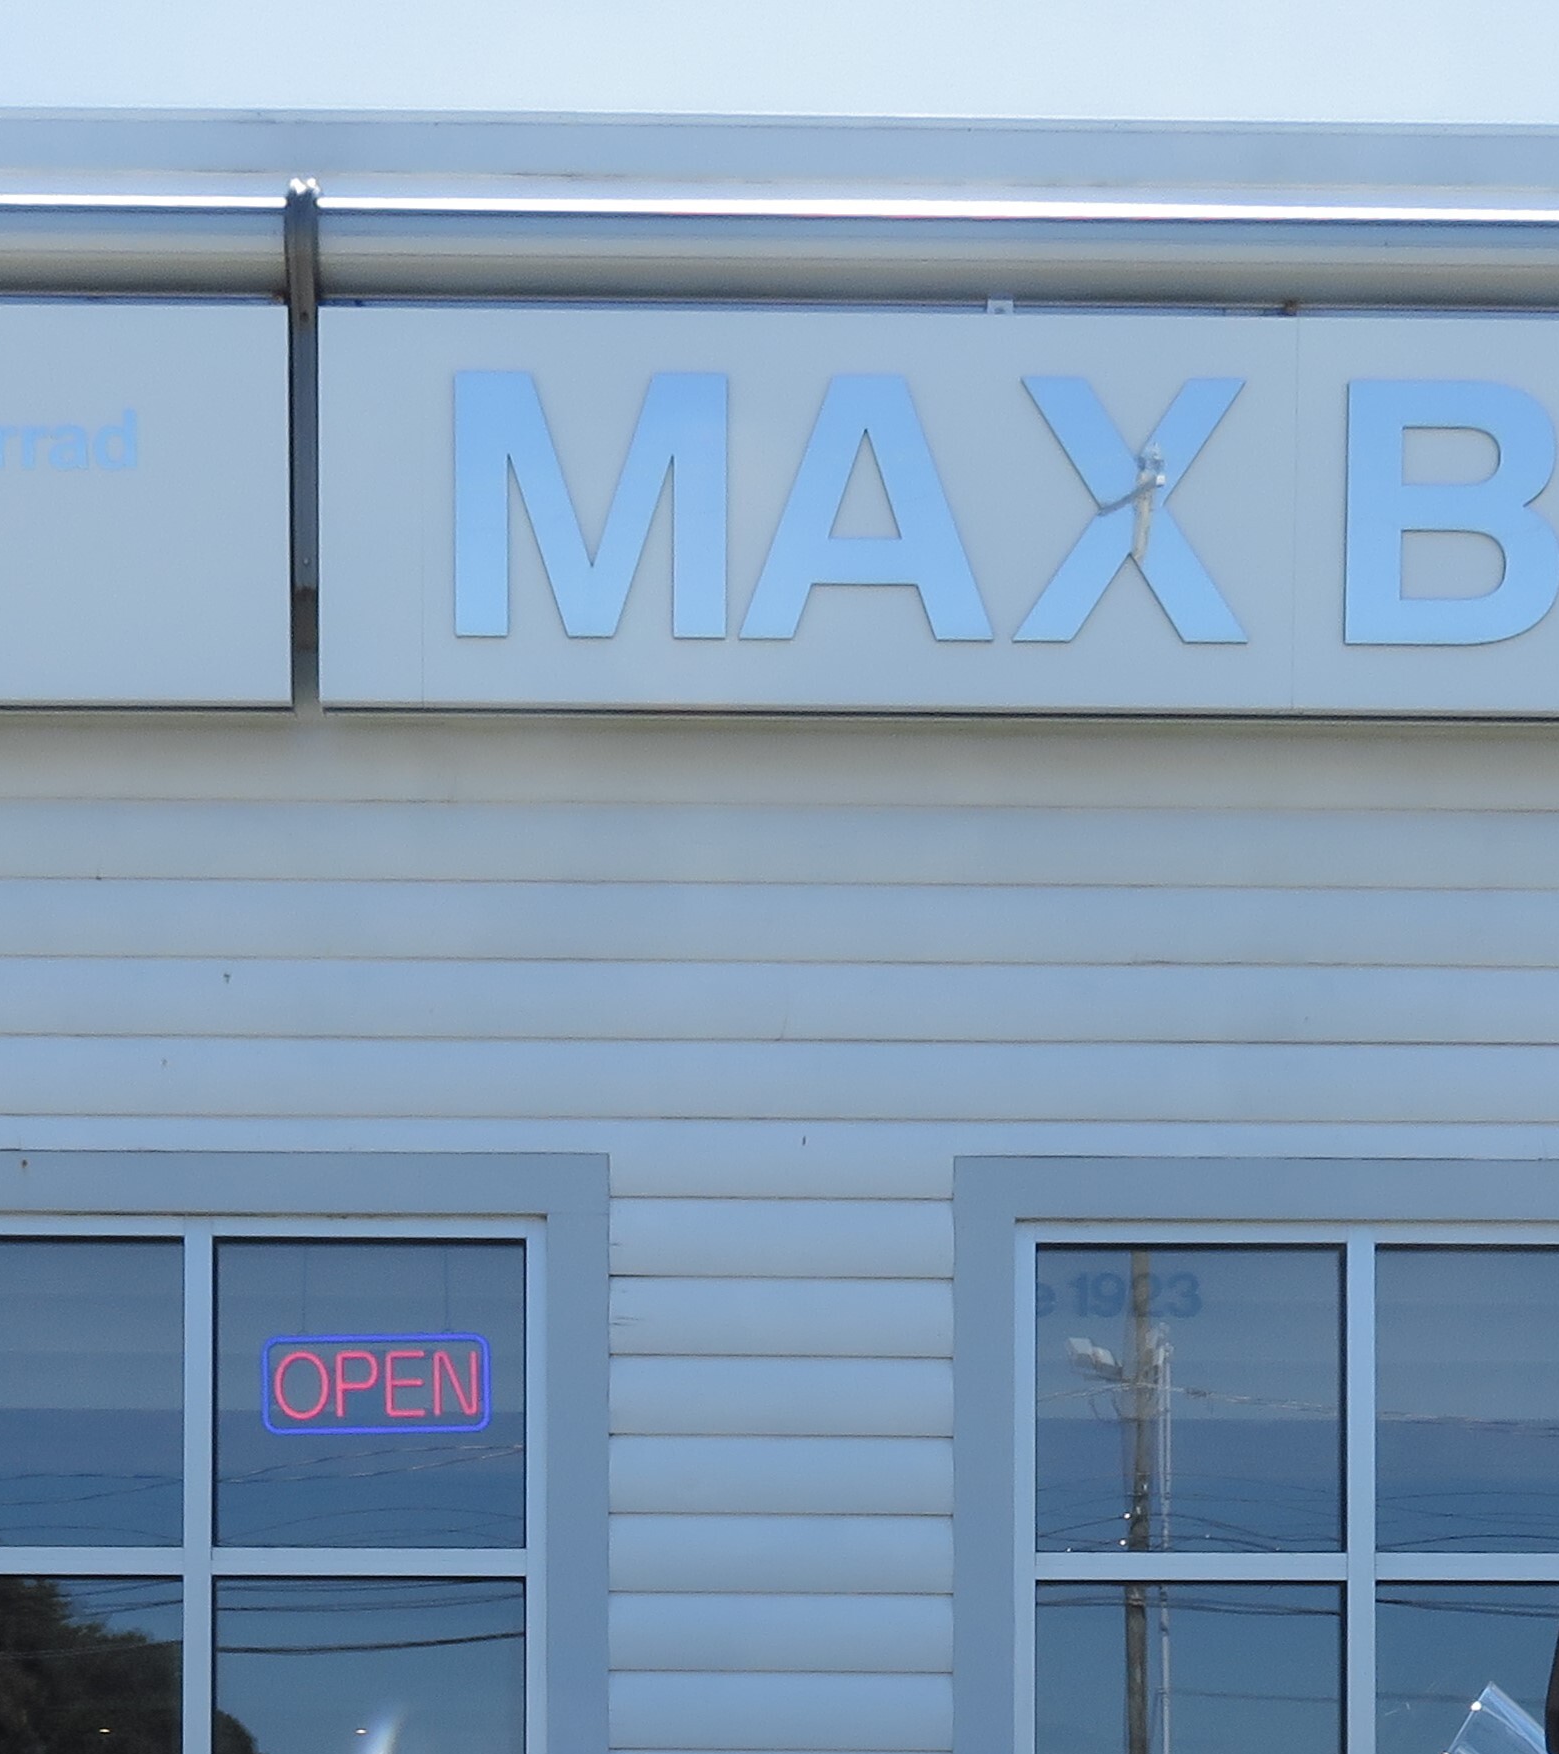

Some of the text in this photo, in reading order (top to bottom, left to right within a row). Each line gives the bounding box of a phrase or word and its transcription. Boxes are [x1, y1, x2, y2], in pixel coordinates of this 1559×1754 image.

[454, 371, 1248, 645] MAX
[1068, 1271, 1203, 1318] 1923
[273, 1350, 480, 1421] OPEN
